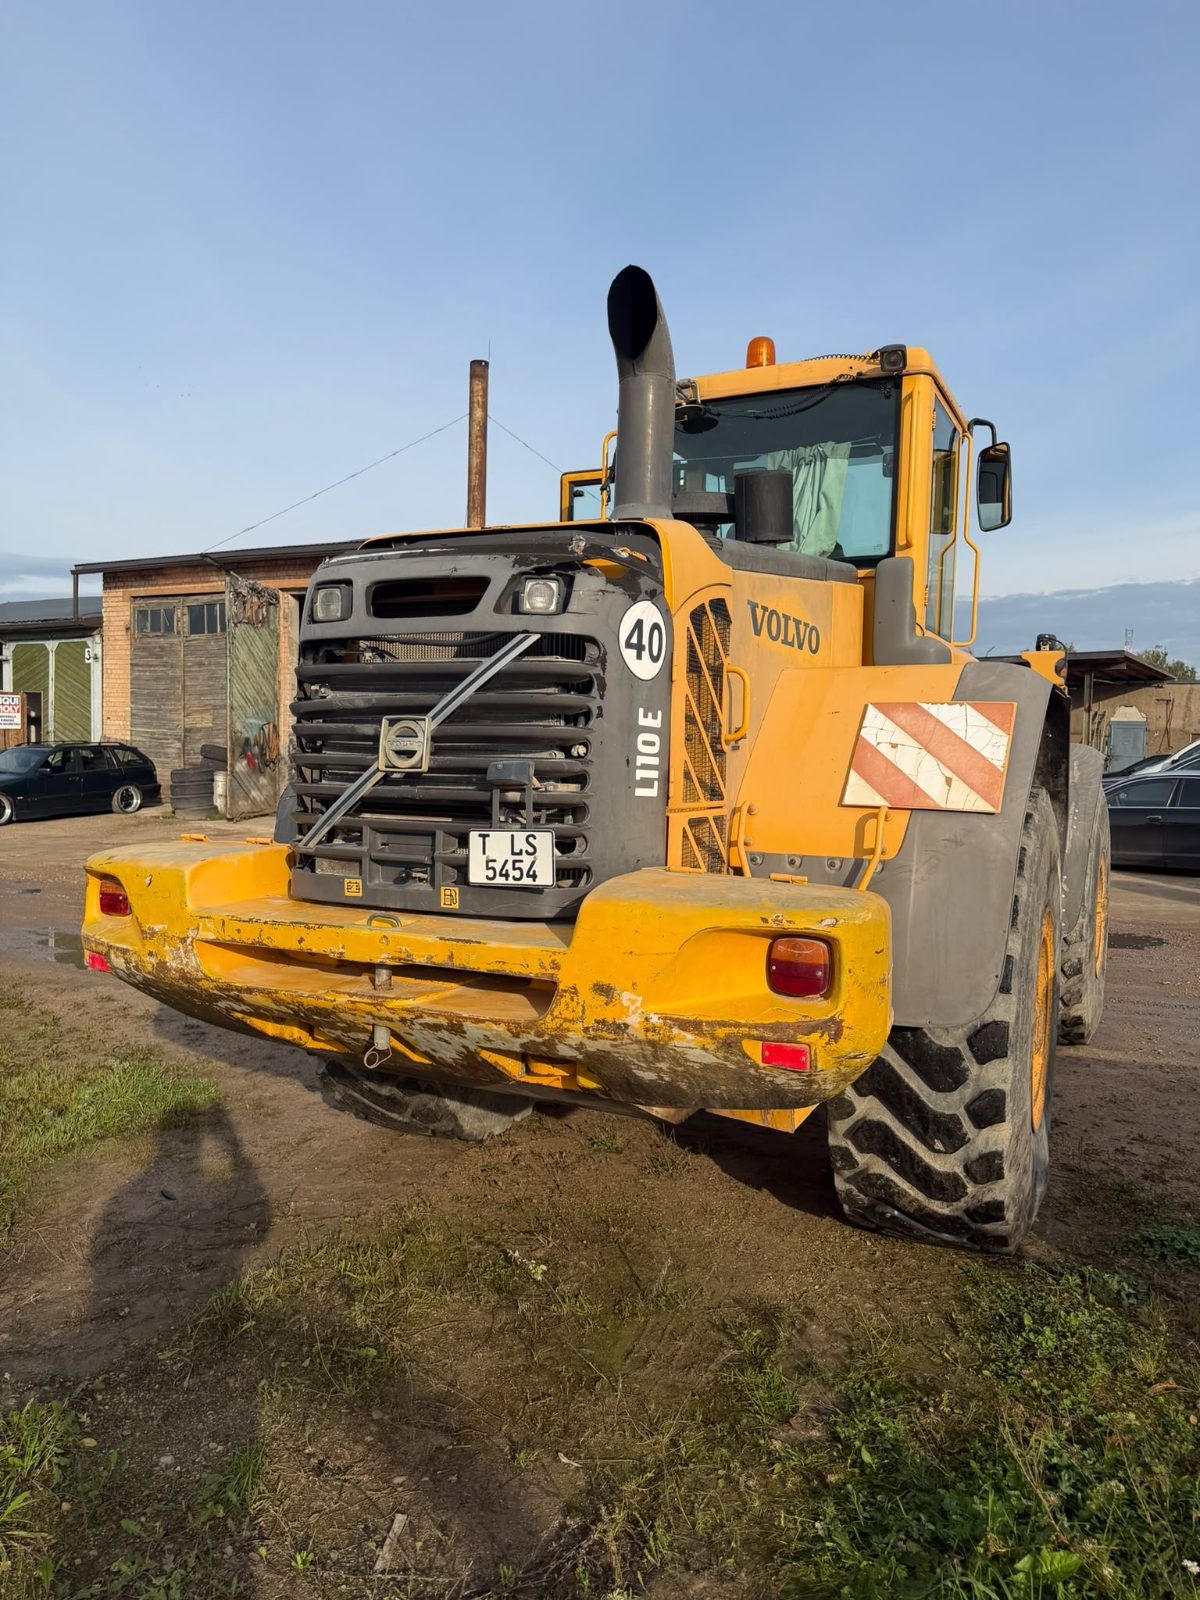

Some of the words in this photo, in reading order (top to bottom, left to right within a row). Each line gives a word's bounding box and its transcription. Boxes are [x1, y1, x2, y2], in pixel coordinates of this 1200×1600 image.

[625, 618, 663, 663] 40
[747, 600, 820, 655] VOLVO
[478, 833, 490, 855] T
[511, 834, 537, 856] LS
[485, 859, 538, 882] 5454
